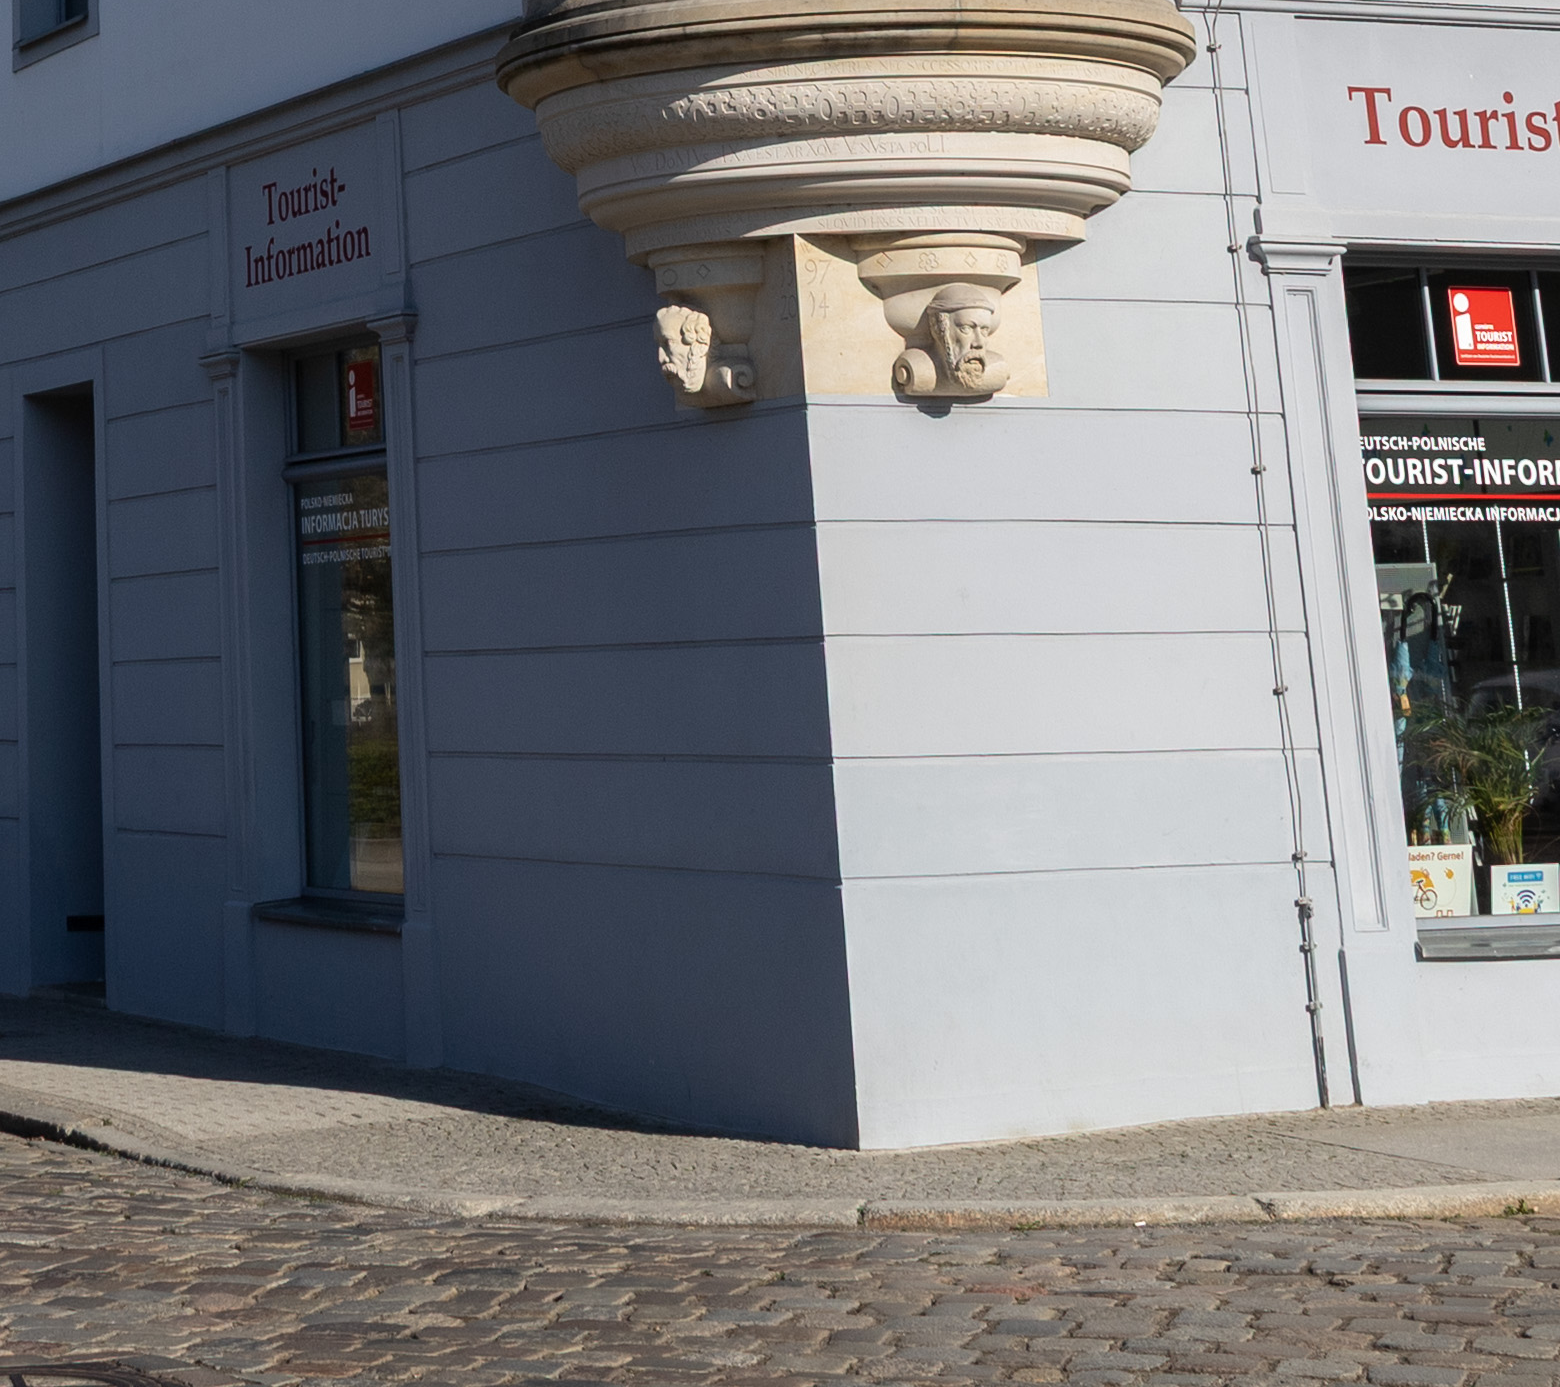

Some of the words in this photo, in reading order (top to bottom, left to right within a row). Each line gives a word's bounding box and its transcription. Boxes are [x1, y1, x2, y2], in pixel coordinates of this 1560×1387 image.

[262, 166, 347, 226] Tourist-
[244, 218, 372, 288] Information
[803, 258, 833, 286] 97
[1475, 331, 1513, 342] TOURIST
[300, 492, 354, 510] POLSKO-NIEMIECKA
[301, 510, 359, 535] INFORMACJA
[302, 547, 362, 565] DEUTSCH-POLNISCHE
[1437, 851, 1465, 861] Gerne!
